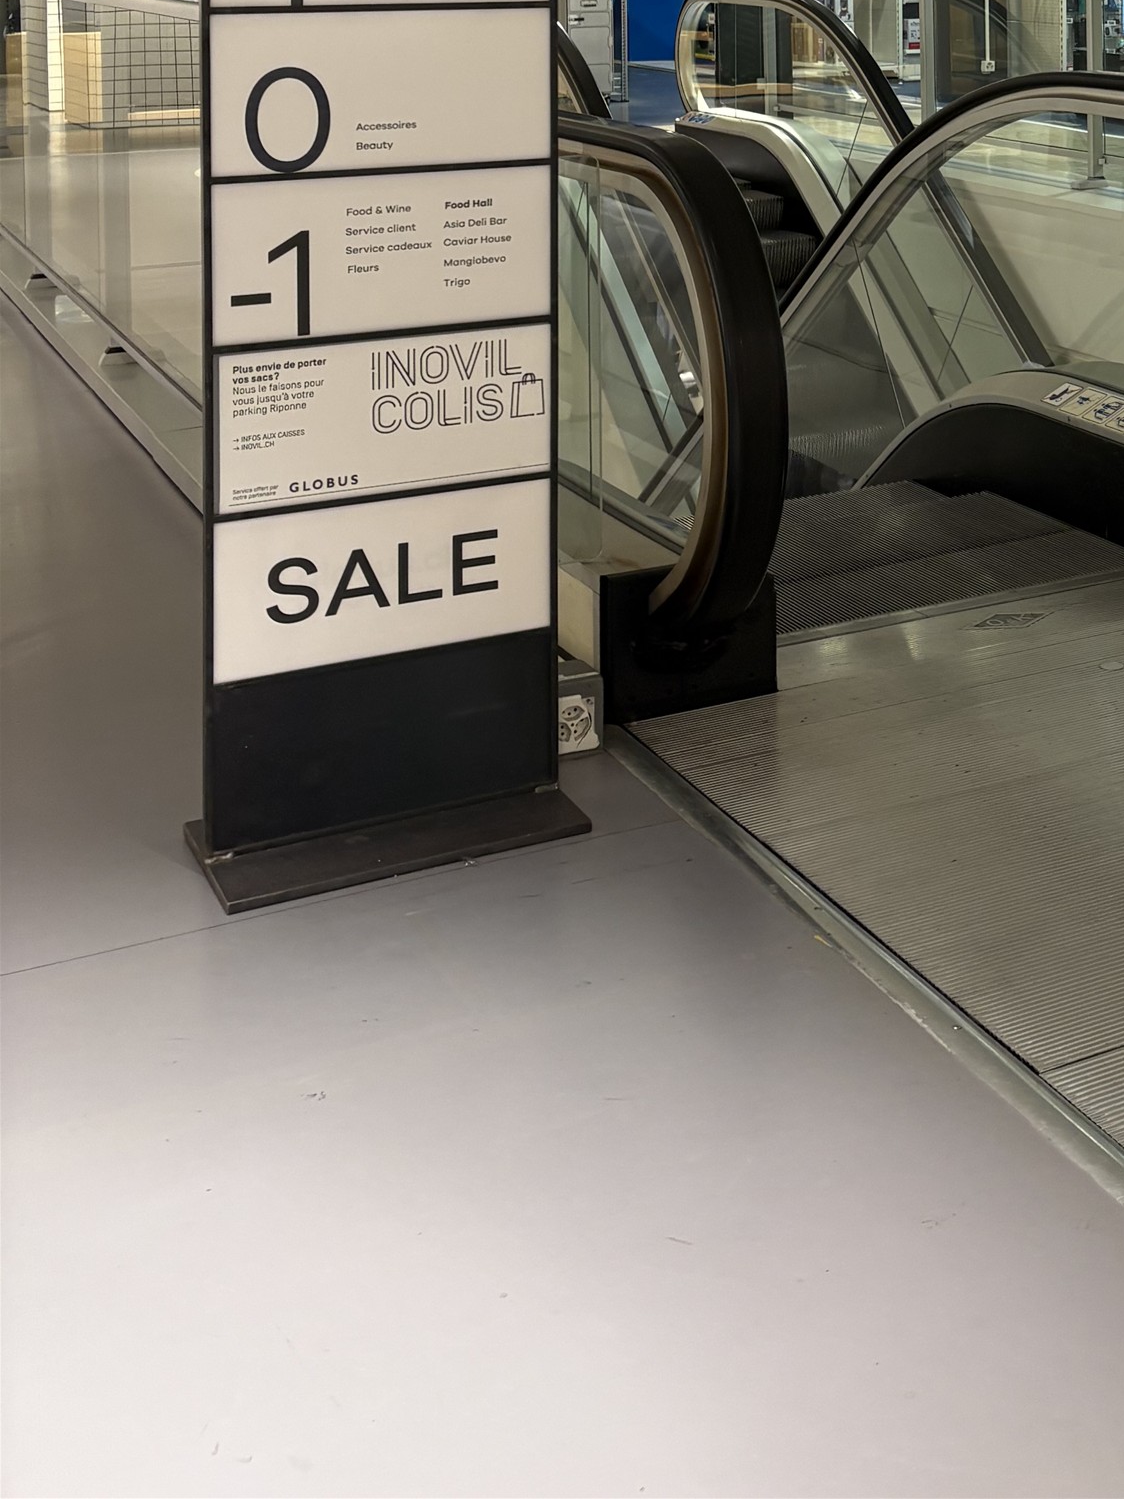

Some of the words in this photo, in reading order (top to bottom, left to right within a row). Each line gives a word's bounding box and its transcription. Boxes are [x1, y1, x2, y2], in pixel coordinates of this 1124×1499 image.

[245, 67, 331, 173] 0
[356, 120, 417, 131] Accessoires
[356, 140, 394, 151] Beauty
[346, 206, 372, 216] Food
[375, 206, 383, 214] &
[385, 205, 412, 214] Wine
[444, 200, 470, 210] Food
[472, 198, 493, 208] Hall
[346, 227, 384, 236] Service
[387, 224, 416, 233] client
[443, 220, 466, 229] Asia
[468, 218, 487, 227] Deli
[489, 217, 508, 226] Bar
[443, 237, 478, 247] Caviar
[480, 234, 512, 244] House
[346, 245, 384, 255] Service
[387, 241, 432, 252] cadeaux
[347, 264, 379, 274] Fleurs
[443, 255, 506, 269] Mangiobevo
[231, 230, 310, 336] -1
[443, 278, 470, 288] Trigo
[232, 365, 254, 374] Plus
[255, 363, 281, 372] envie
[283, 361, 295, 370] de
[297, 358, 327, 369] porter
[371, 338, 523, 392] INOVIL
[232, 376, 249, 384] vos
[251, 372, 280, 383] sacs?
[232, 386, 256, 395] Nous
[258, 384, 267, 393] le
[269, 381, 302, 392] faisons
[304, 379, 324, 388] pour
[232, 397, 254, 406] vous
[256, 392, 289, 405] jusqu'à
[291, 390, 315, 400] votre
[232, 406, 268, 418] parking
[269, 402, 307, 414] Riponne
[371, 383, 505, 434] COLIS
[241, 434, 261, 443] INFOS
[262, 432, 276, 441] AUX
[277, 429, 305, 439] CAISSES
[289, 474, 359, 493] GLOBUS
[266, 528, 499, 624] SALE
